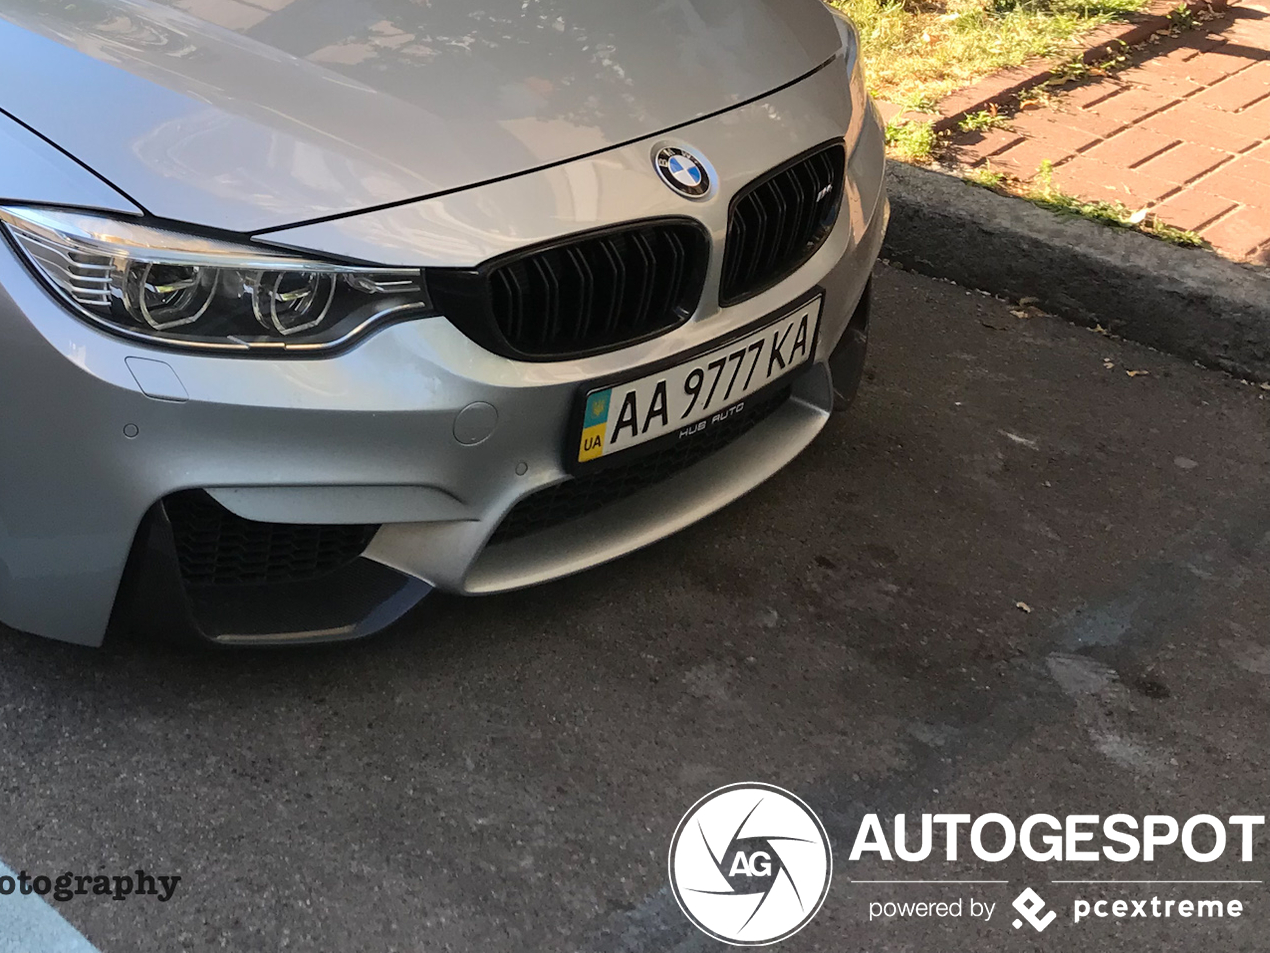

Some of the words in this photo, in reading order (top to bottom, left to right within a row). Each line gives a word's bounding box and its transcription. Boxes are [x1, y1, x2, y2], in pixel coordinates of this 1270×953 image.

[658, 148, 692, 167] BMW
[610, 379, 668, 444] AA
[681, 339, 765, 419] 9777
[767, 313, 808, 378] KA
[679, 421, 706, 439] HUB
[711, 402, 744, 424] AUTO
[584, 435, 602, 451] UA
